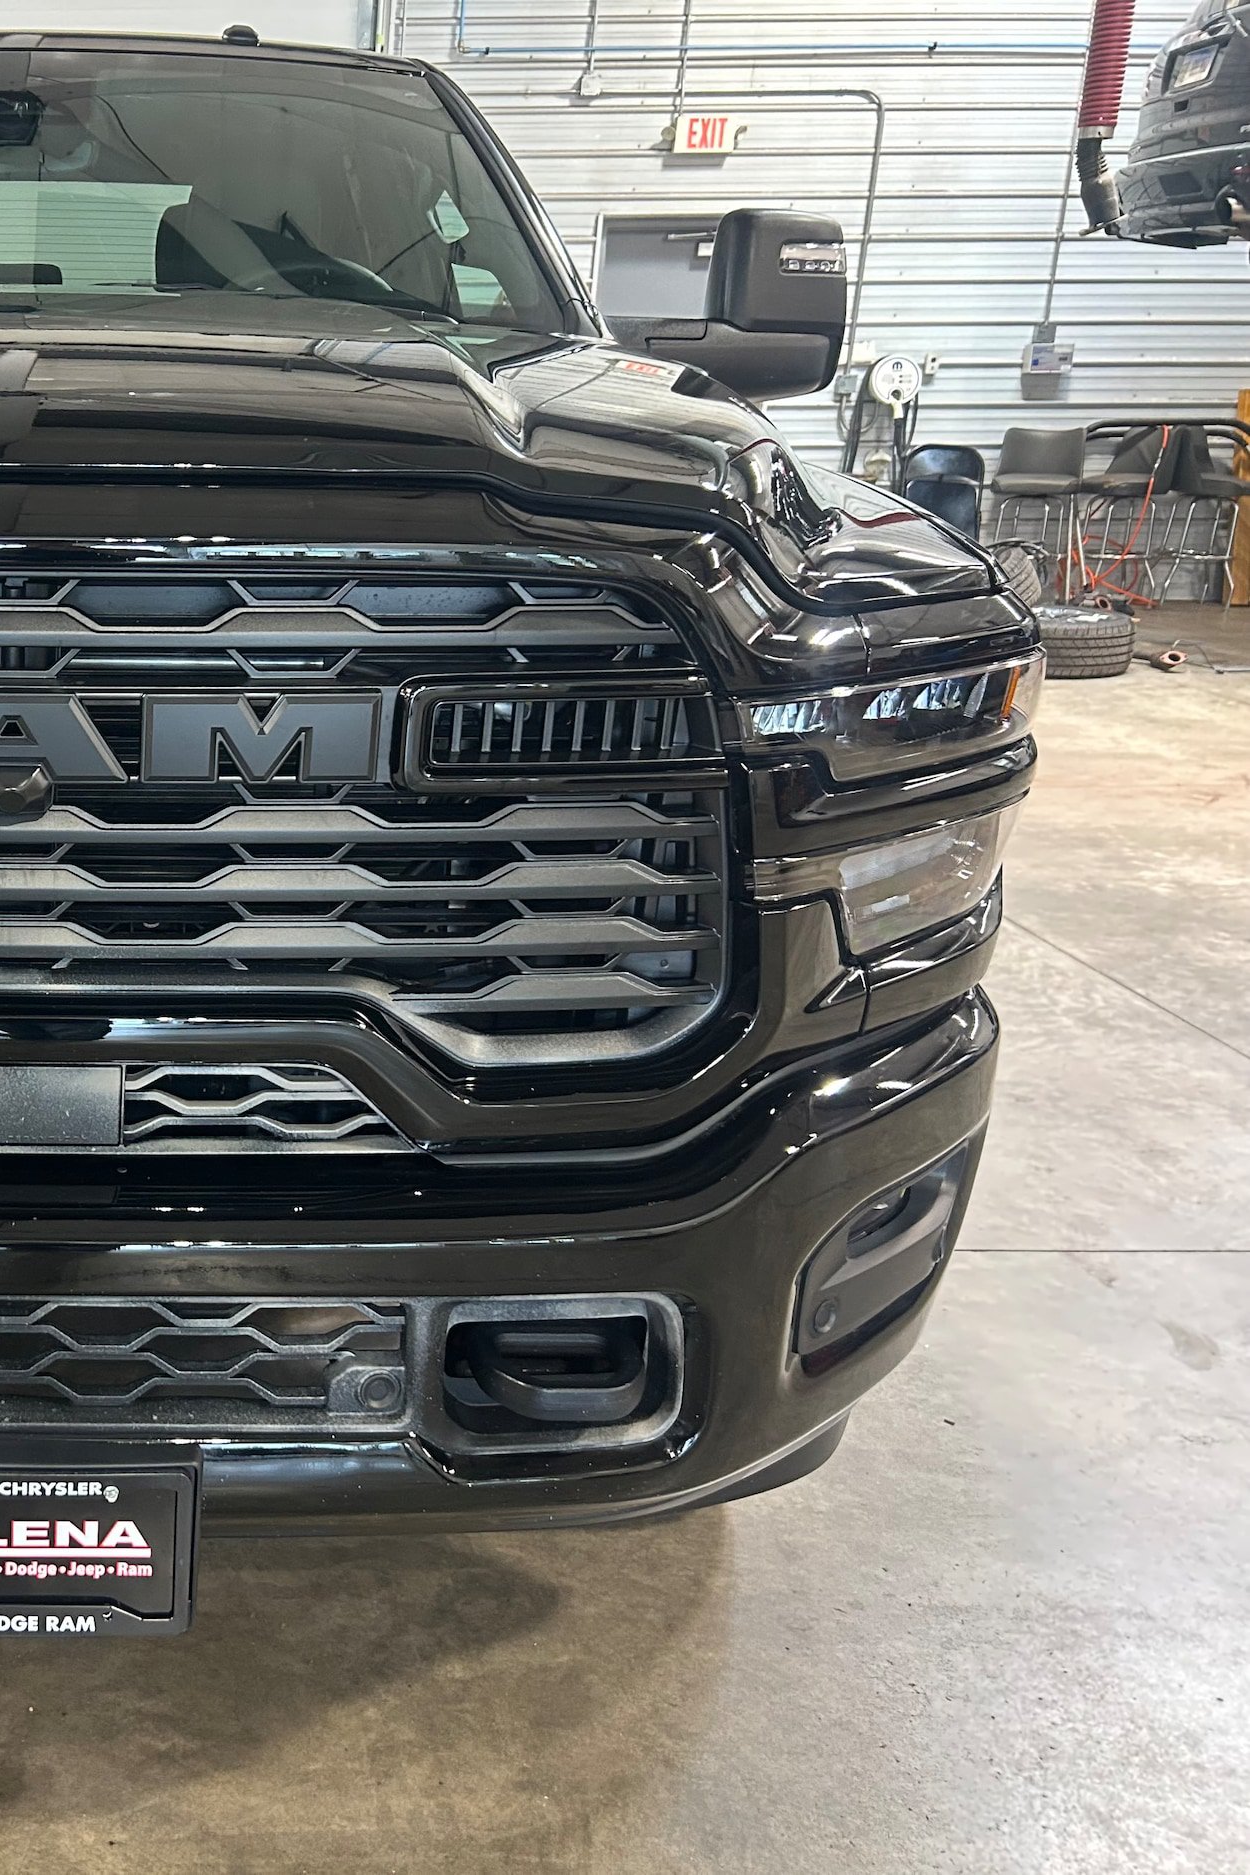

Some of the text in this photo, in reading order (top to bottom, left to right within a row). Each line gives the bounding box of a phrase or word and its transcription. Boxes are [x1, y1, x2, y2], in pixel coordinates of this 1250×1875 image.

[687, 118, 728, 148] EXIT
[4, 1560, 57, 1579] Dodge
[67, 1561, 106, 1579] Jeep
[117, 1562, 153, 1577] Ram
[45, 1615, 96, 1632] RAM
